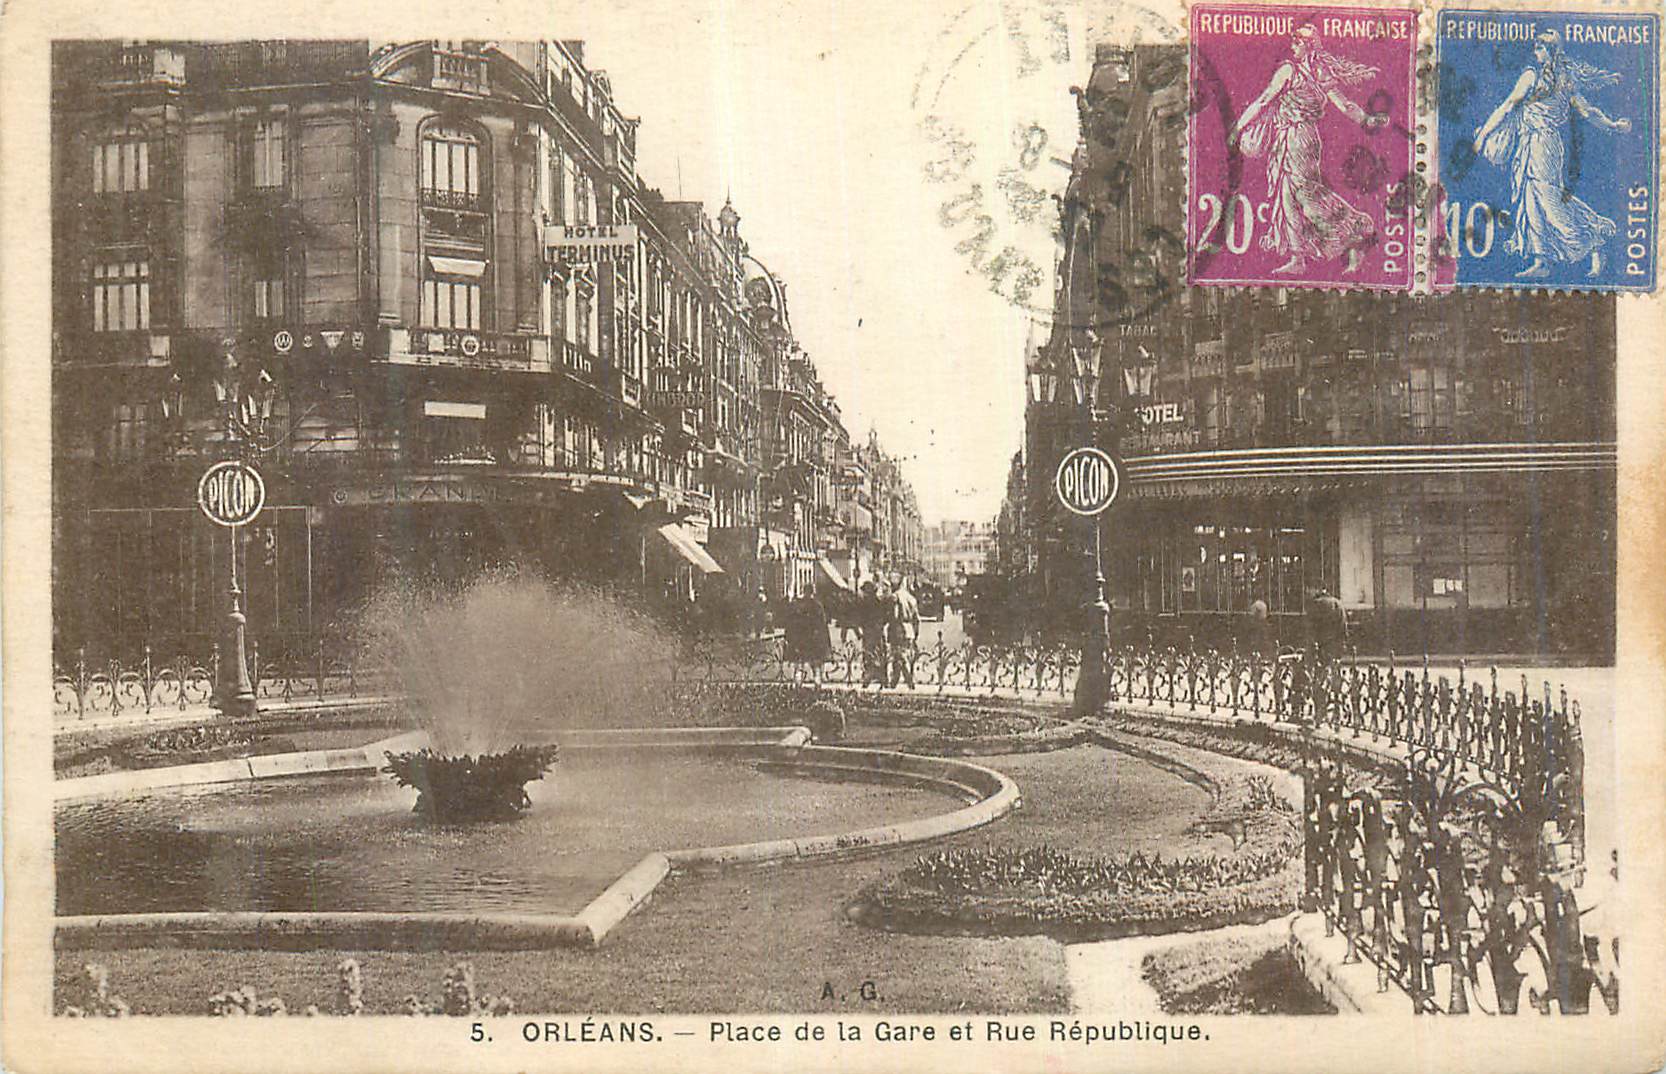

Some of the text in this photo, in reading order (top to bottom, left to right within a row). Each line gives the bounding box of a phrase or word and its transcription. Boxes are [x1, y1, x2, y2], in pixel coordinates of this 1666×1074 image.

[1323, 18, 1409, 42] FRANÇAISE
[1565, 24, 1650, 48] FRANÇAISE
[564, 226, 618, 239] HOTEL
[1626, 185, 1650, 276] POSTES
[546, 244, 636, 263] TERMINUS
[1064, 454, 1109, 507] PICON
[207, 467, 256, 520] PICON
